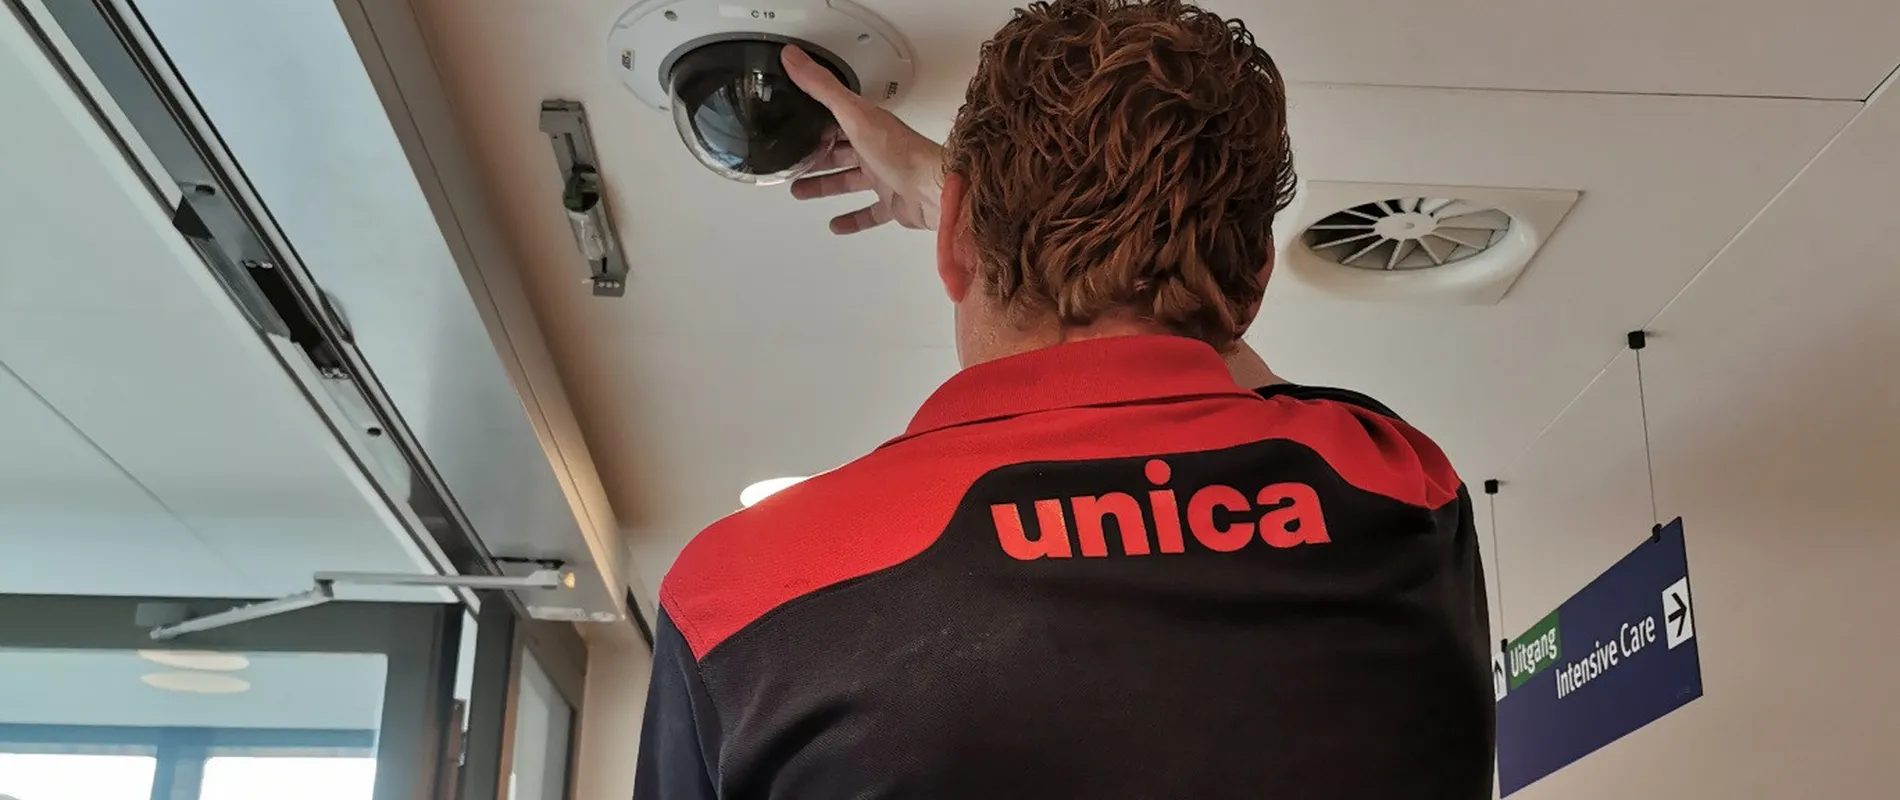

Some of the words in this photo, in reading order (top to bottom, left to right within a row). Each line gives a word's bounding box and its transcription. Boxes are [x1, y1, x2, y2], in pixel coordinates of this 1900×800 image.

[750, 9, 760, 19] C
[763, 10, 776, 19] 19
[990, 459, 1331, 560] unica
[1510, 627, 1557, 677] Uitgang
[1555, 640, 1618, 699] Intensive
[1620, 616, 1655, 657] Care
